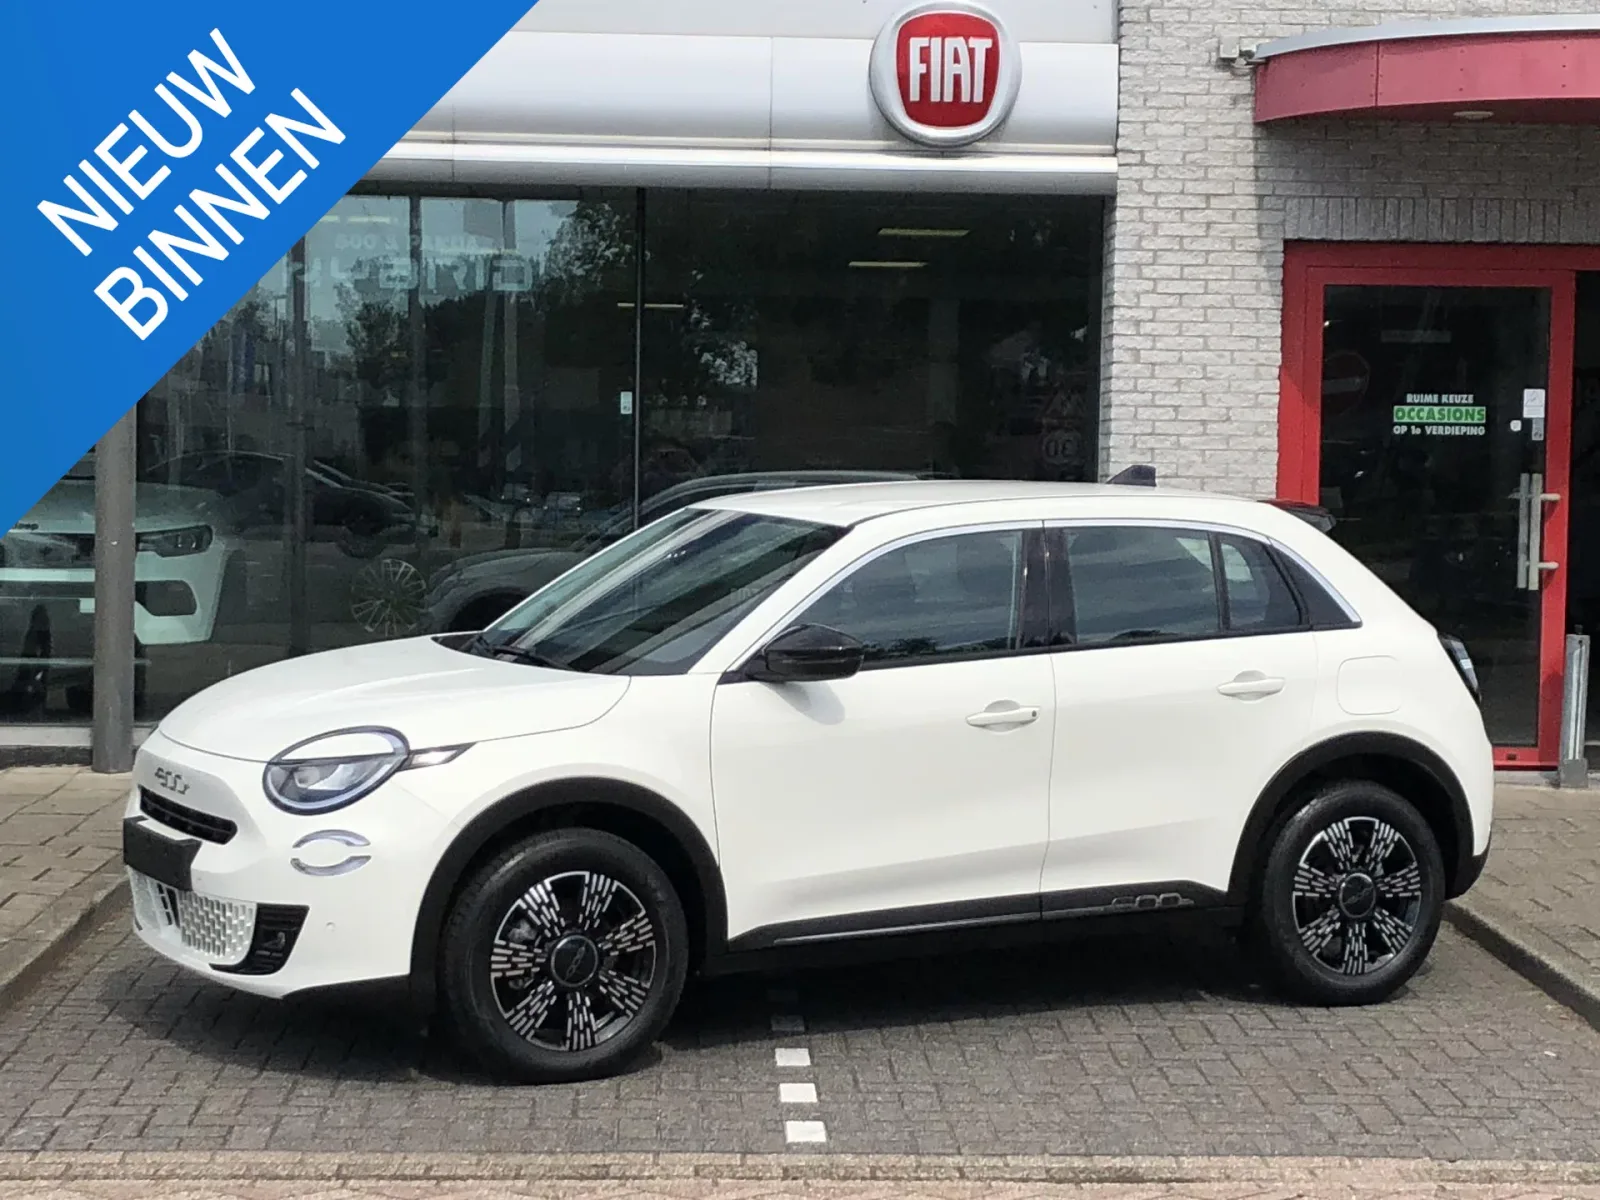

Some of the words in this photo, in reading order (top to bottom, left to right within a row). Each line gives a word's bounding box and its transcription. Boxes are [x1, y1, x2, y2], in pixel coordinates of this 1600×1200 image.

[909, 36, 993, 103] FIAT
[1406, 393, 1439, 404] RUIME
[1441, 394, 1474, 404] KEUZE
[1396, 408, 1485, 422] OCCASIONS
[1393, 425, 1408, 435] OP
[1425, 426, 1486, 436] VERDIEPING
